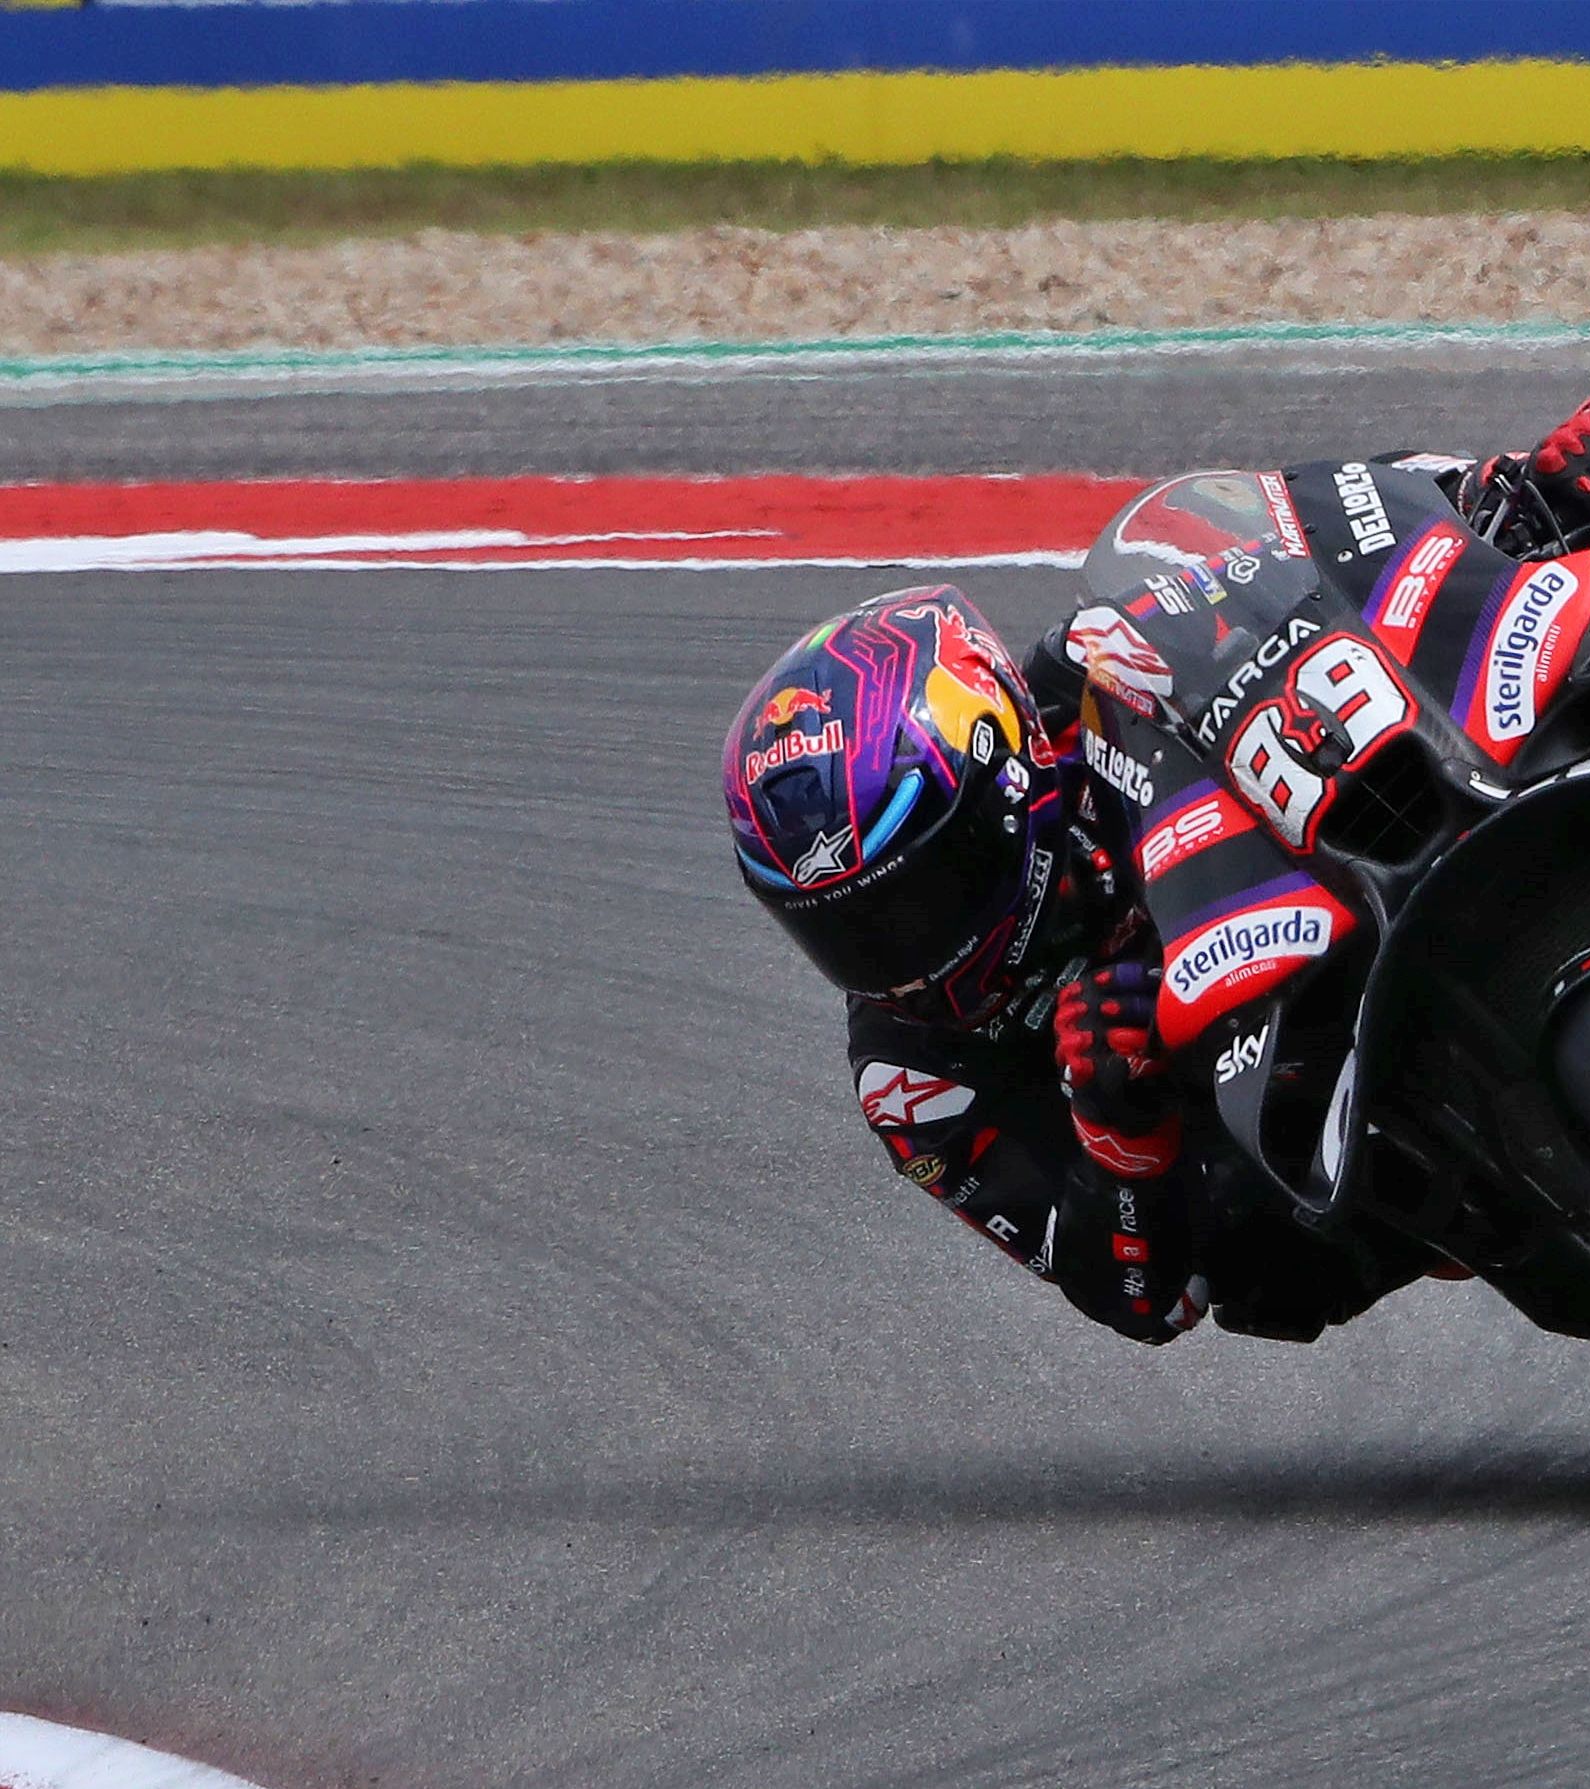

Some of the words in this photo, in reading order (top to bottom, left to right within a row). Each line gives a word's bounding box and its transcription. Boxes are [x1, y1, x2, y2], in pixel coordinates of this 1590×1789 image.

[1382, 536, 1455, 629] BS
[1197, 617, 1322, 743] TARGA
[1497, 570, 1565, 730] sterilgarda
[1536, 623, 1562, 683] alimenti
[746, 740, 784, 784] Red
[782, 719, 844, 763] Bull
[1230, 637, 1408, 848] 89
[1142, 800, 1223, 879] BS
[1173, 909, 1321, 993] sterilgarda
[1223, 958, 1277, 988] alimenti
[1215, 1024, 1269, 1084] sky
